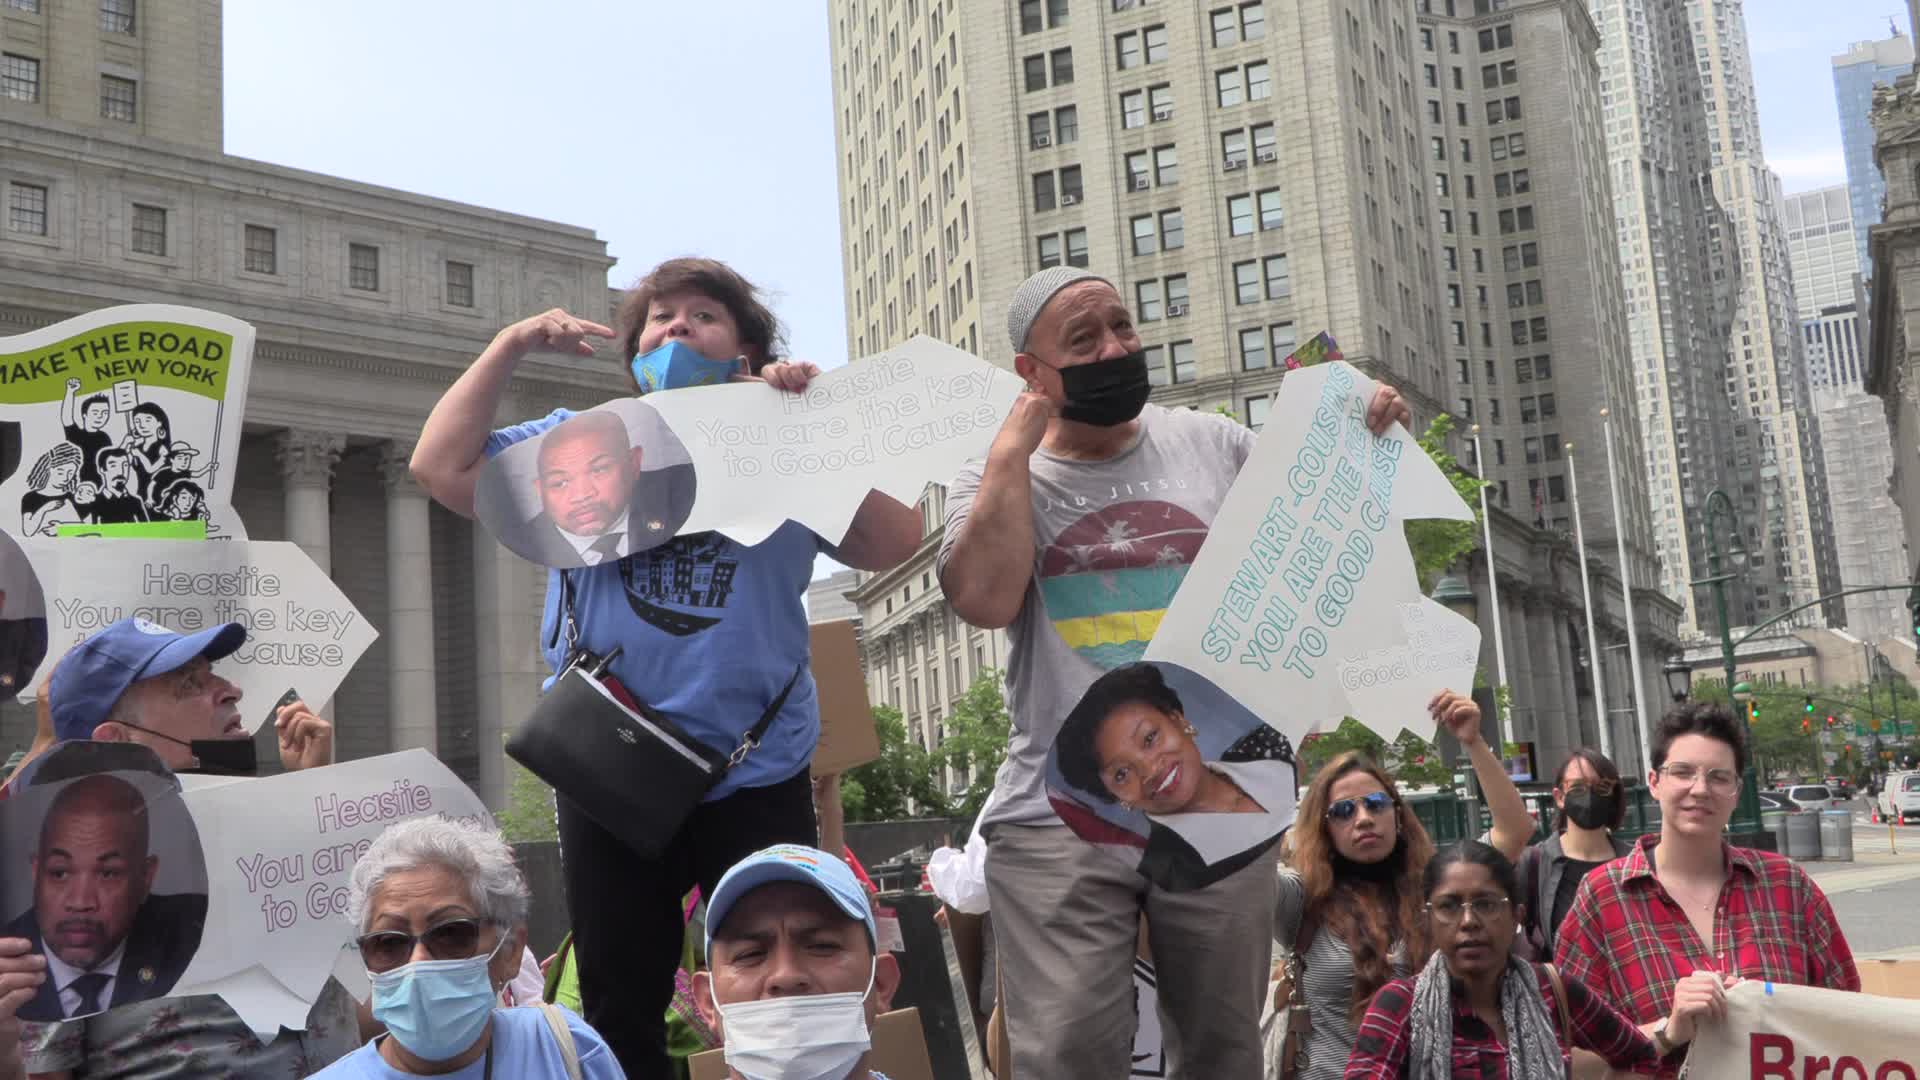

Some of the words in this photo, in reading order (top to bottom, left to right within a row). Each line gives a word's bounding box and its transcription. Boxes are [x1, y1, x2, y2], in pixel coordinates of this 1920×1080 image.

[70, 332, 131, 365] THE
[138, 332, 224, 362] ROAD
[95, 358, 150, 382] NEW
[157, 359, 219, 386] YORK
[781, 354, 916, 415] Heastie
[696, 416, 769, 448] You
[776, 415, 849, 445] are
[856, 392, 921, 430] the
[722, 449, 761, 478] to
[770, 435, 875, 478] Good
[882, 403, 999, 458] Cause
[1110, 479, 1188, 499] JITSU
[142, 564, 281, 598] Heastie
[1240, 596, 1298, 672] YOU
[1282, 526, 1333, 603] ARE
[1313, 456, 1363, 531] THE
[1283, 626, 1328, 679] TO
[1315, 529, 1375, 628] GOOD
[1360, 432, 1403, 533] CAUSE
[55, 598, 122, 629] You
[132, 606, 203, 631] are
[215, 600, 276, 631] the
[286, 601, 354, 641] key
[231, 635, 343, 667] Cause
[1342, 656, 1409, 691] Good
[1413, 649, 1477, 674] Cae
[313, 779, 432, 834] Heastie
[236, 853, 304, 893] You
[312, 838, 373, 876] are
[261, 894, 298, 932] to
[306, 881, 351, 920] Go
